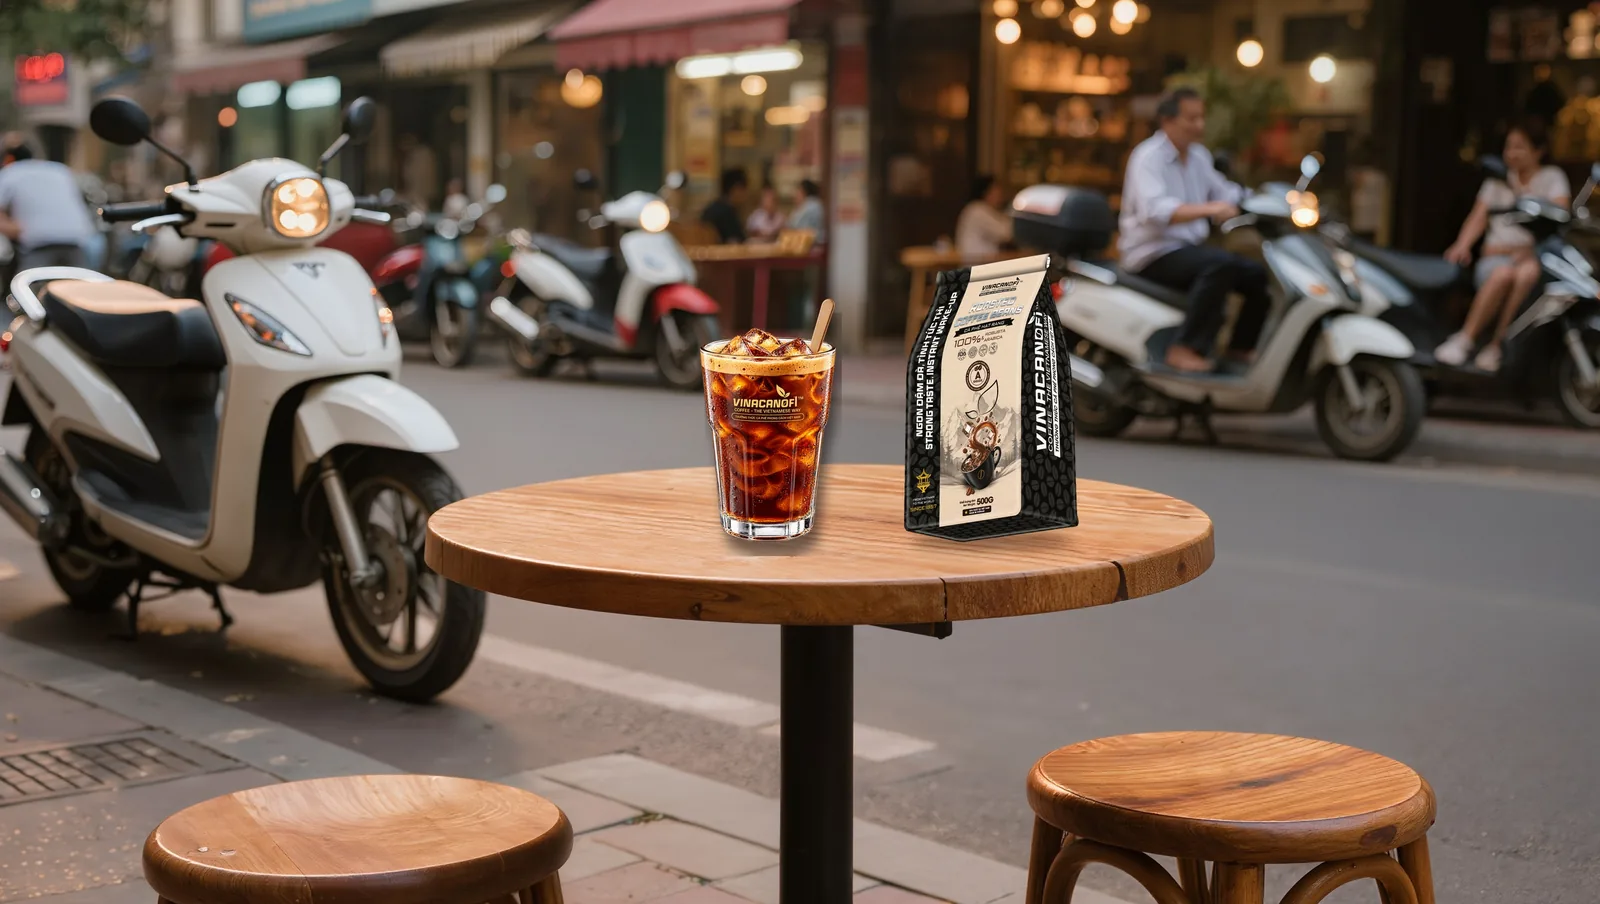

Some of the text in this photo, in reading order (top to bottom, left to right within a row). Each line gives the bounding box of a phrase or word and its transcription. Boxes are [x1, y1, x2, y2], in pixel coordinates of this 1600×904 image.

[936, 291, 958, 335] WAKE-UP
[953, 305, 1024, 328] COFFEE BEANS
[969, 296, 1017, 313] ROASTED
[926, 336, 941, 376] INSTANT
[954, 335, 981, 348] 100%
[1043, 328, 1051, 381] VIETNAMESE
[916, 408, 924, 437] NGON
[925, 410, 934, 450] STRONG
[976, 496, 994, 505] 500G
